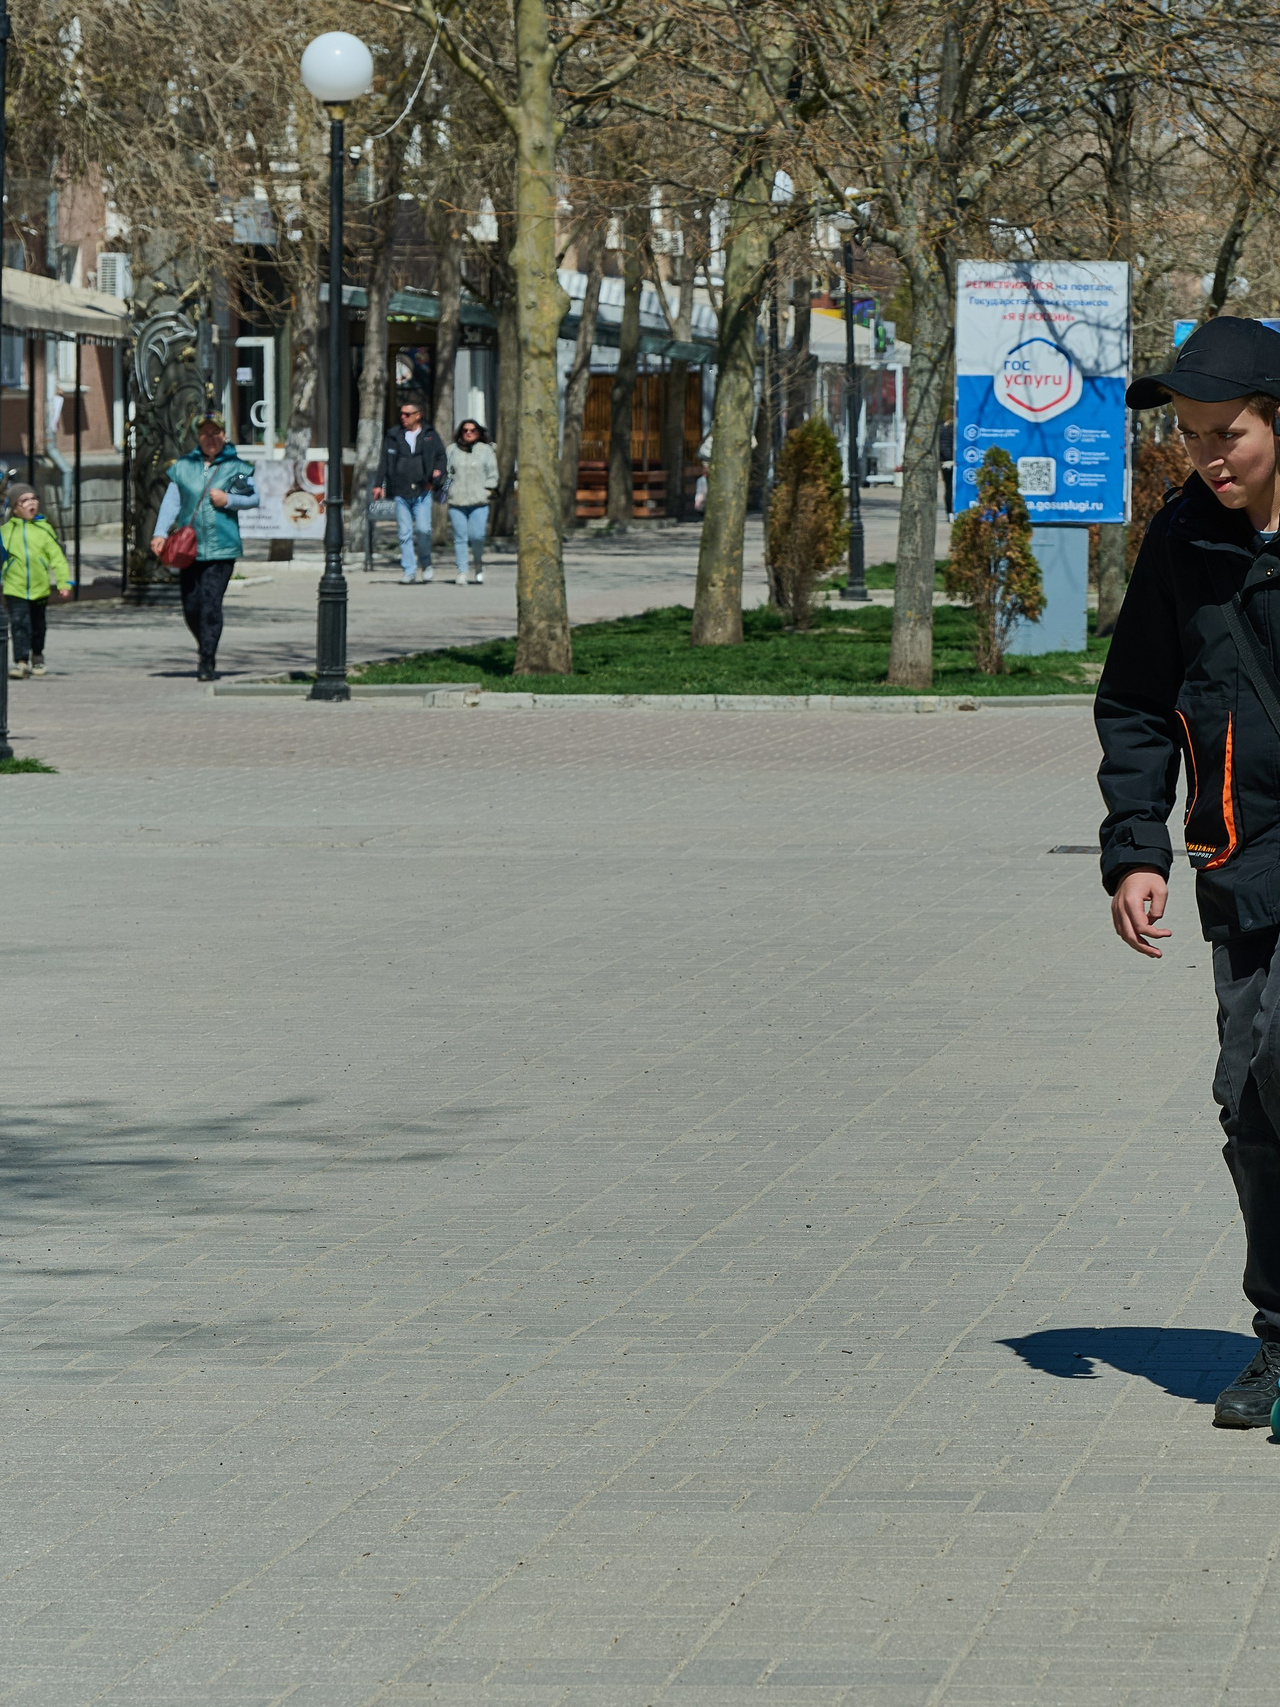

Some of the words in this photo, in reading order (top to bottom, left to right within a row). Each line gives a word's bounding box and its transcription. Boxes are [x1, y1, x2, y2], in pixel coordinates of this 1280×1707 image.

[969, 296, 1059, 307] Государствеых
[1004, 359, 1031, 371] гос
[1004, 373, 1062, 388] услуги
